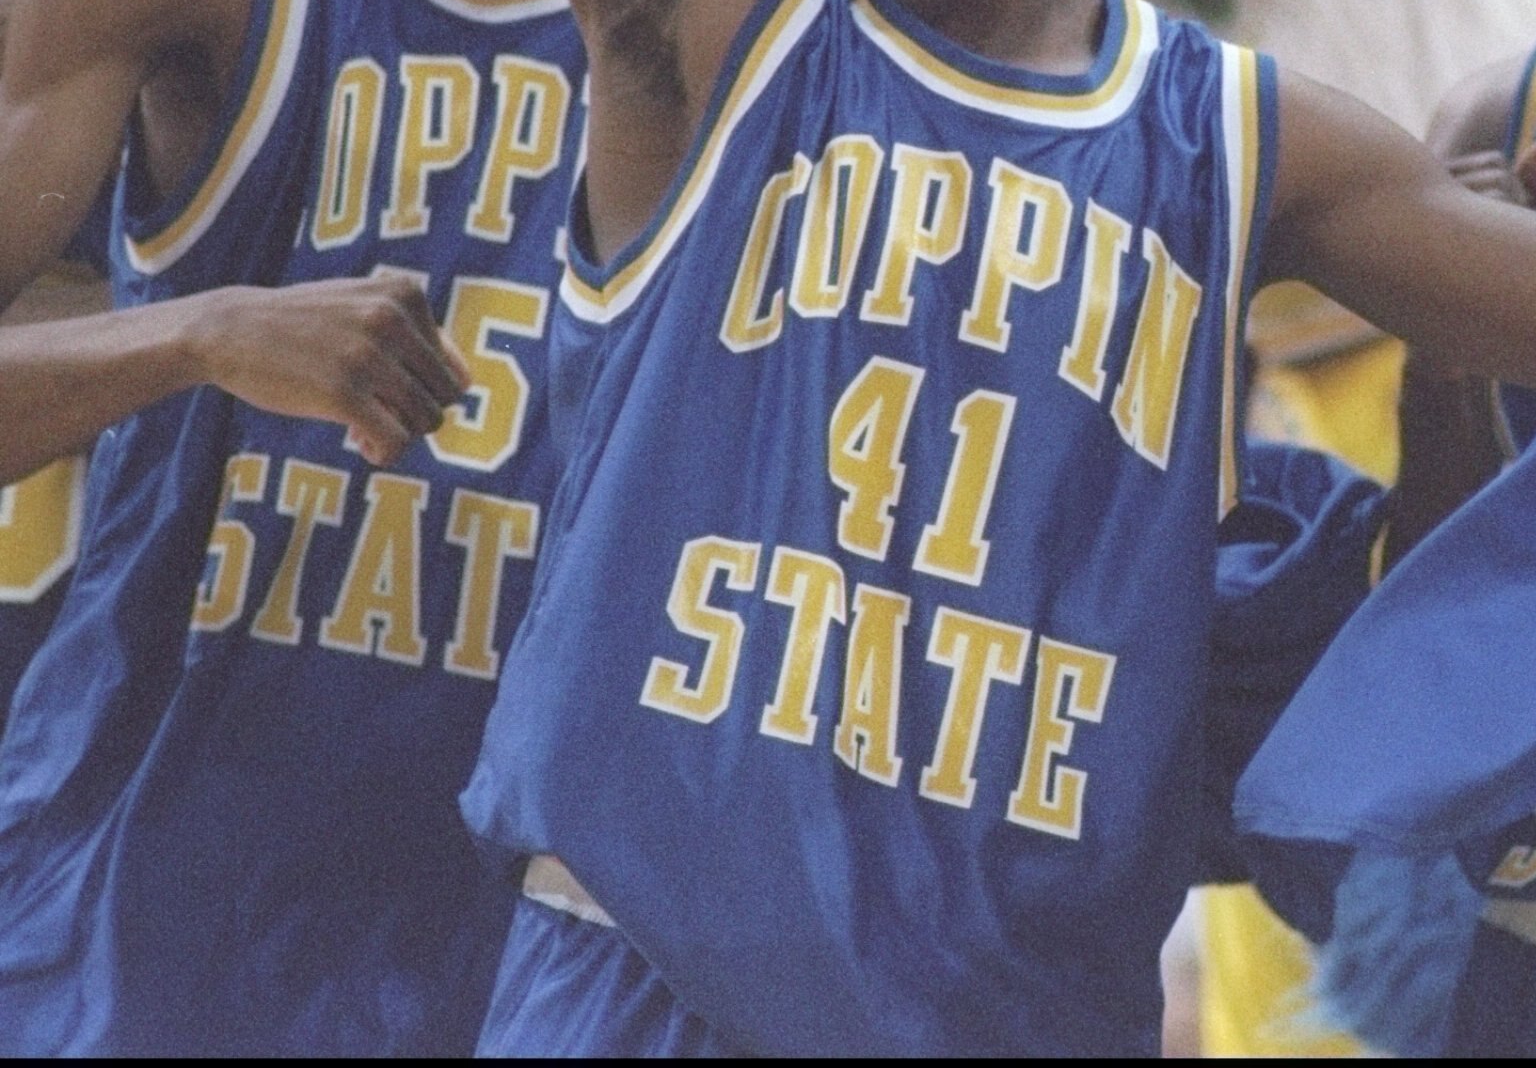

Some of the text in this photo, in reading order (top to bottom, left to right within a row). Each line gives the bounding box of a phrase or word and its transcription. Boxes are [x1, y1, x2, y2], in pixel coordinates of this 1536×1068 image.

[296, 54, 591, 251] OPP
[342, 264, 551, 473] 5
[718, 134, 1203, 472] COPPIN
[189, 453, 541, 680] STAT
[828, 354, 1018, 587] 41
[638, 534, 1118, 841] STATE
